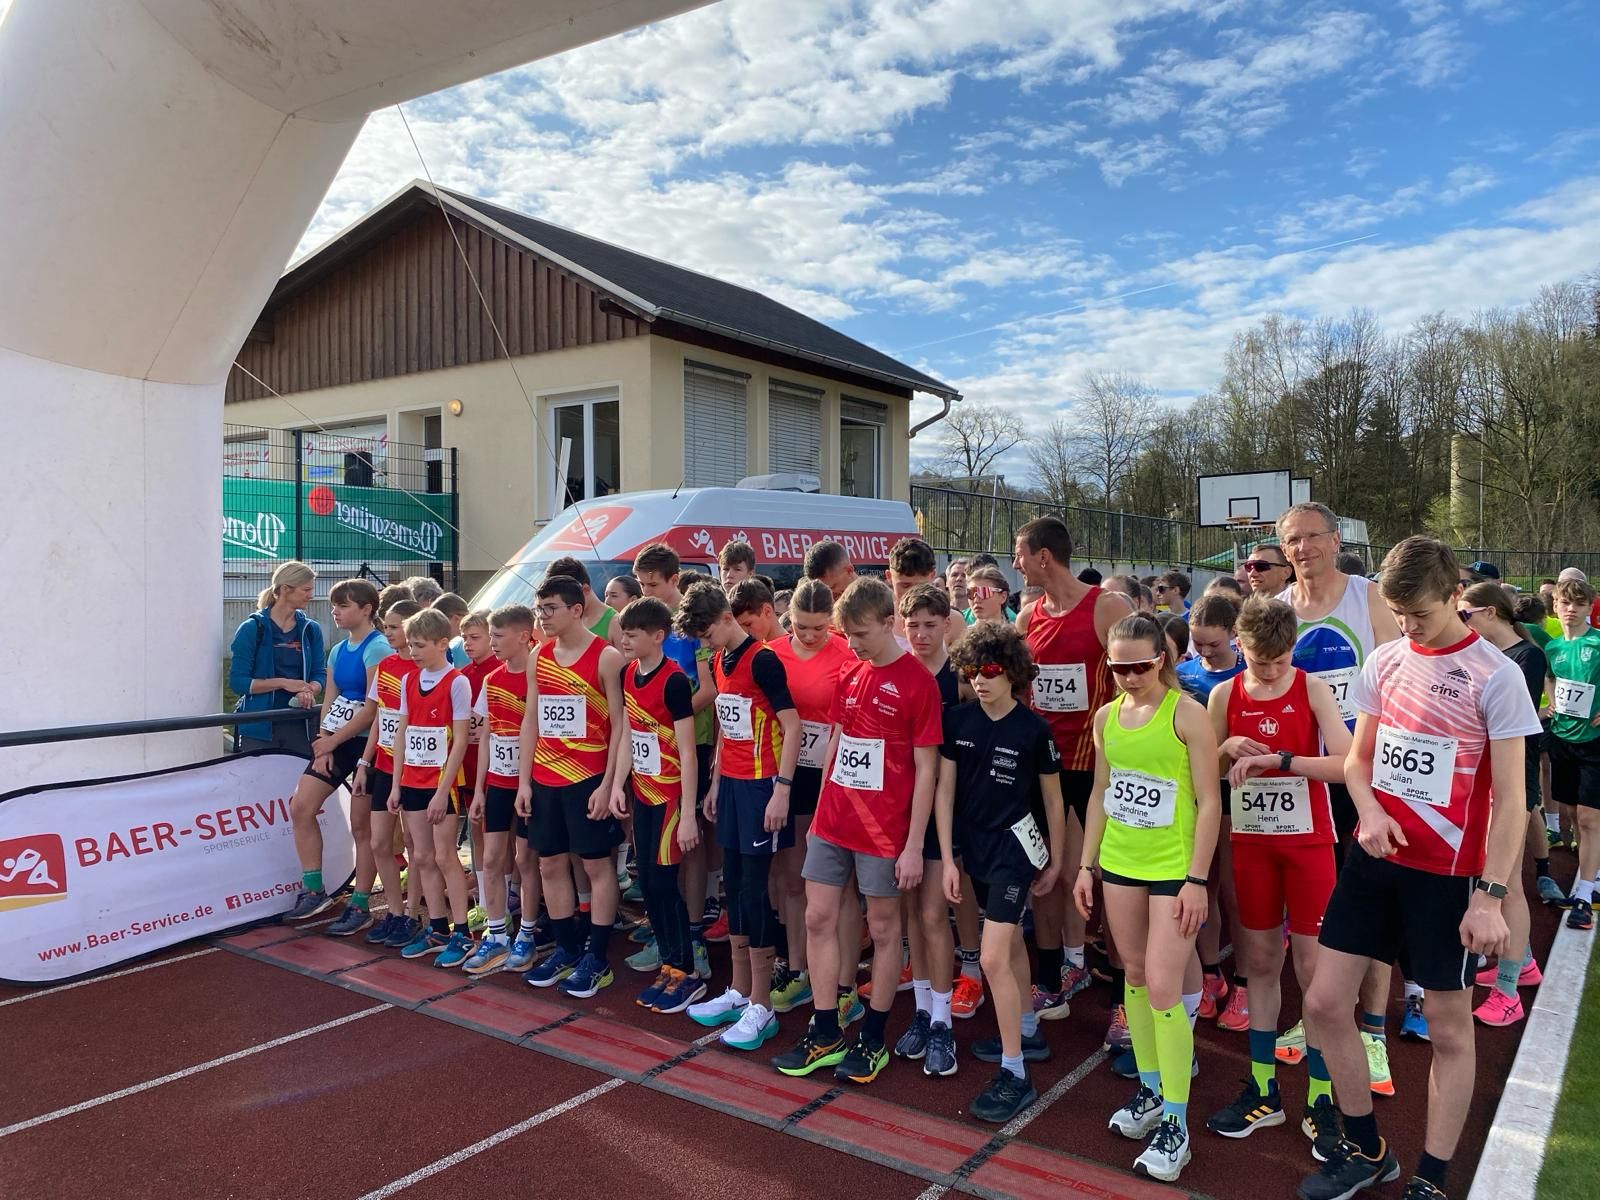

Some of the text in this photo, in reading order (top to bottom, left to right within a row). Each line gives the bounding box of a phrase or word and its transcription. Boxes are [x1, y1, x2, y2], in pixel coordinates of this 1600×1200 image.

[1037, 678, 1077, 694] 5754
[1430, 683, 1460, 699] eins
[543, 706, 575, 721] 5623
[410, 736, 437, 751] 5618
[1381, 742, 1435, 775] 5663
[1390, 771, 1413, 785] Julian
[1113, 780, 1161, 808] 5529
[1406, 788, 1429, 797] SPORT
[1242, 791, 1295, 812] 5478
[1119, 803, 1149, 818] Sandrine
[1257, 814, 1279, 823] Henri
[203, 830, 271, 855] SPORTSERVICE
[38, 904, 214, 962] www.Baer-Service.de
